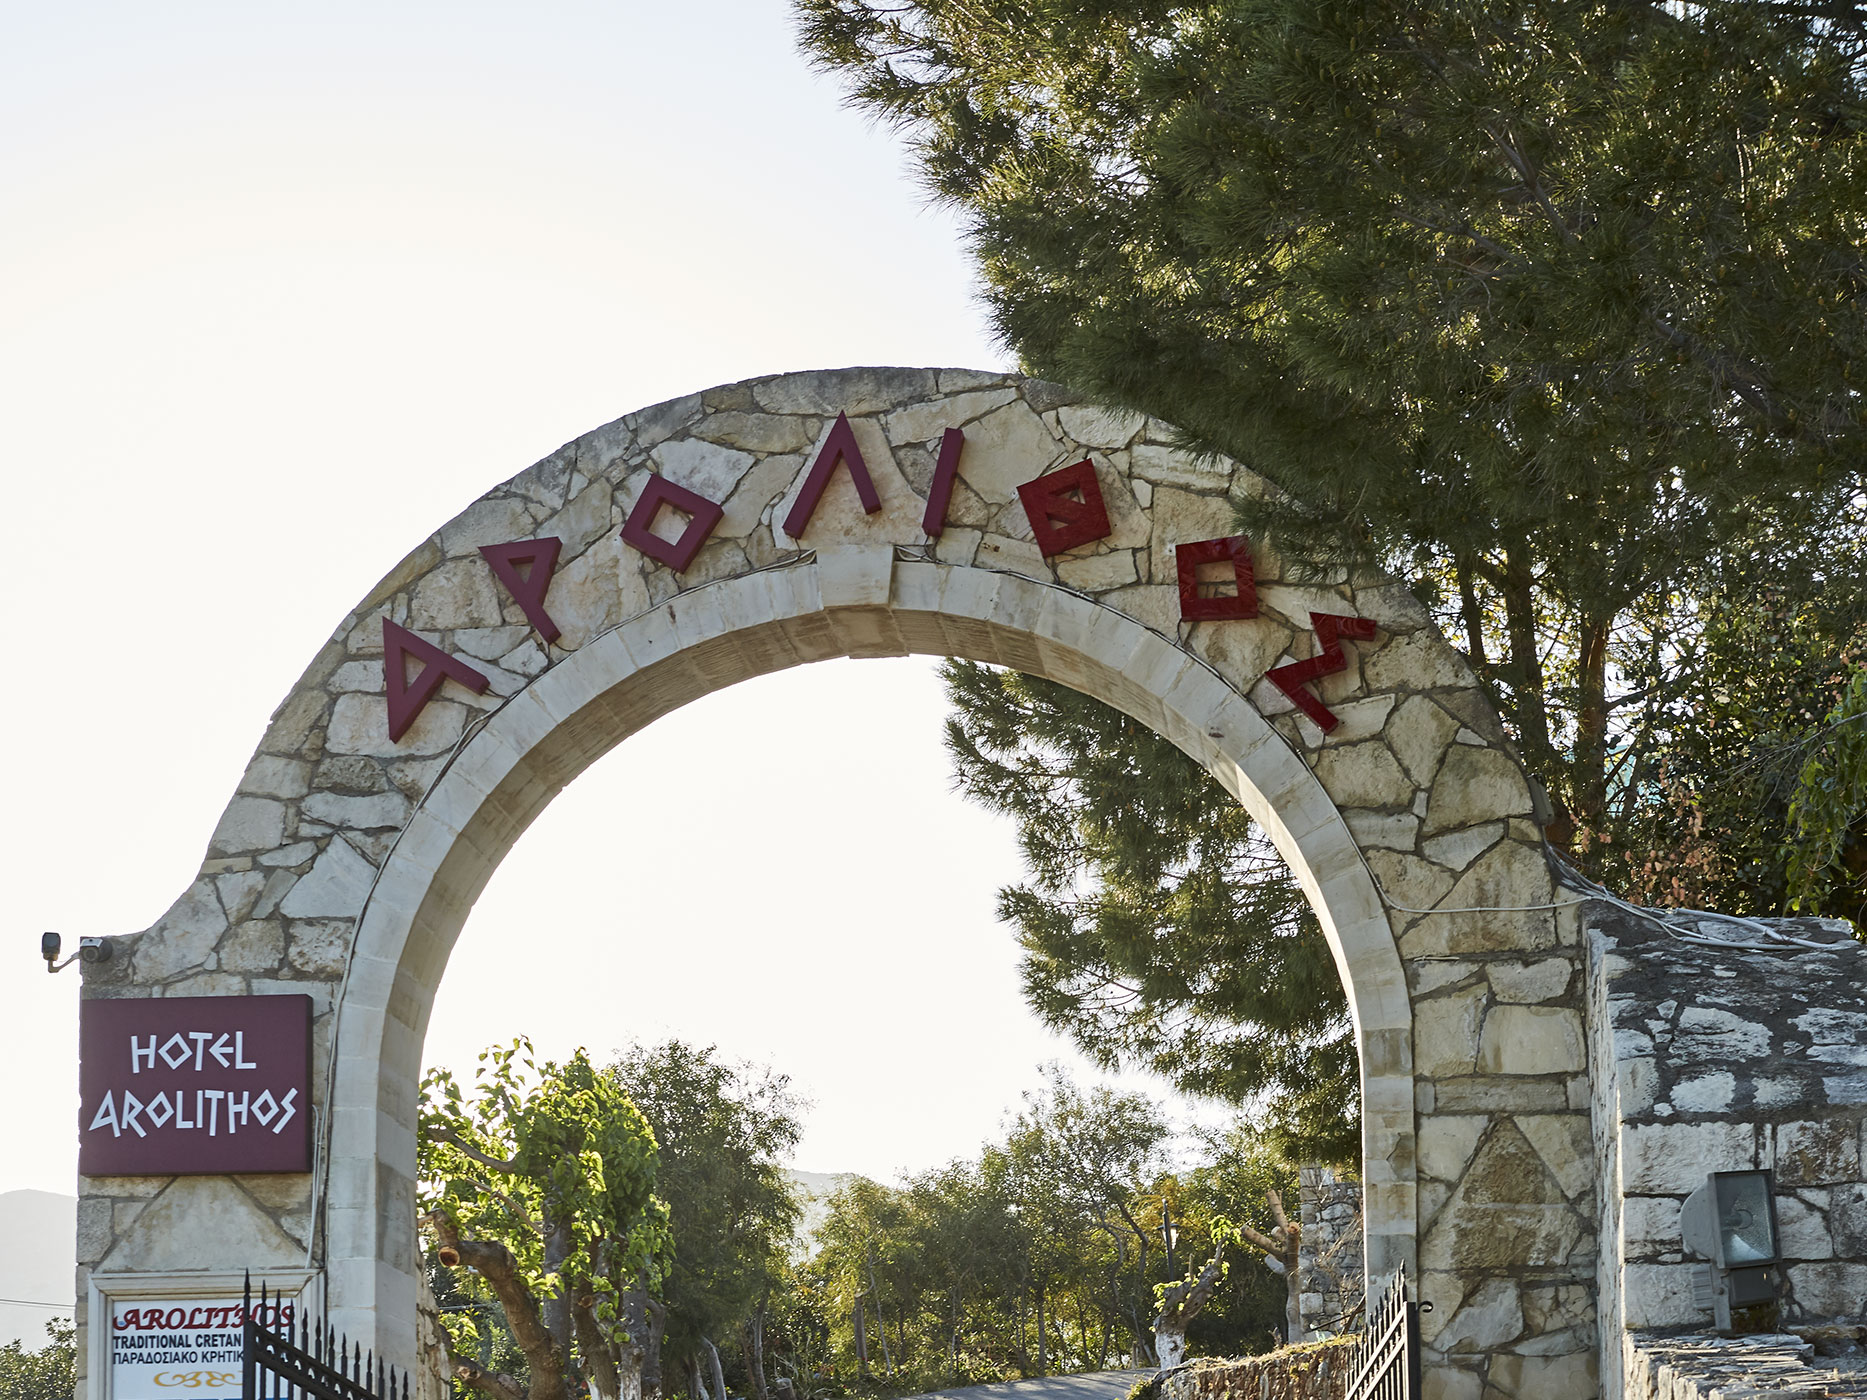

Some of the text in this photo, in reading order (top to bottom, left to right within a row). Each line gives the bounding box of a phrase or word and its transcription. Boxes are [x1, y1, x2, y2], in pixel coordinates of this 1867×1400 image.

[131, 1031, 257, 1074] HOTEL
[88, 1087, 298, 1138] AROLITHOS
[114, 1334, 192, 1350] TRADITIONAL
[195, 1333, 242, 1348] CRETAN
[113, 1350, 245, 1365] ΠΑΡΑΔΟΣΙΑΚΟ ΚΡΗΤΙΚ
